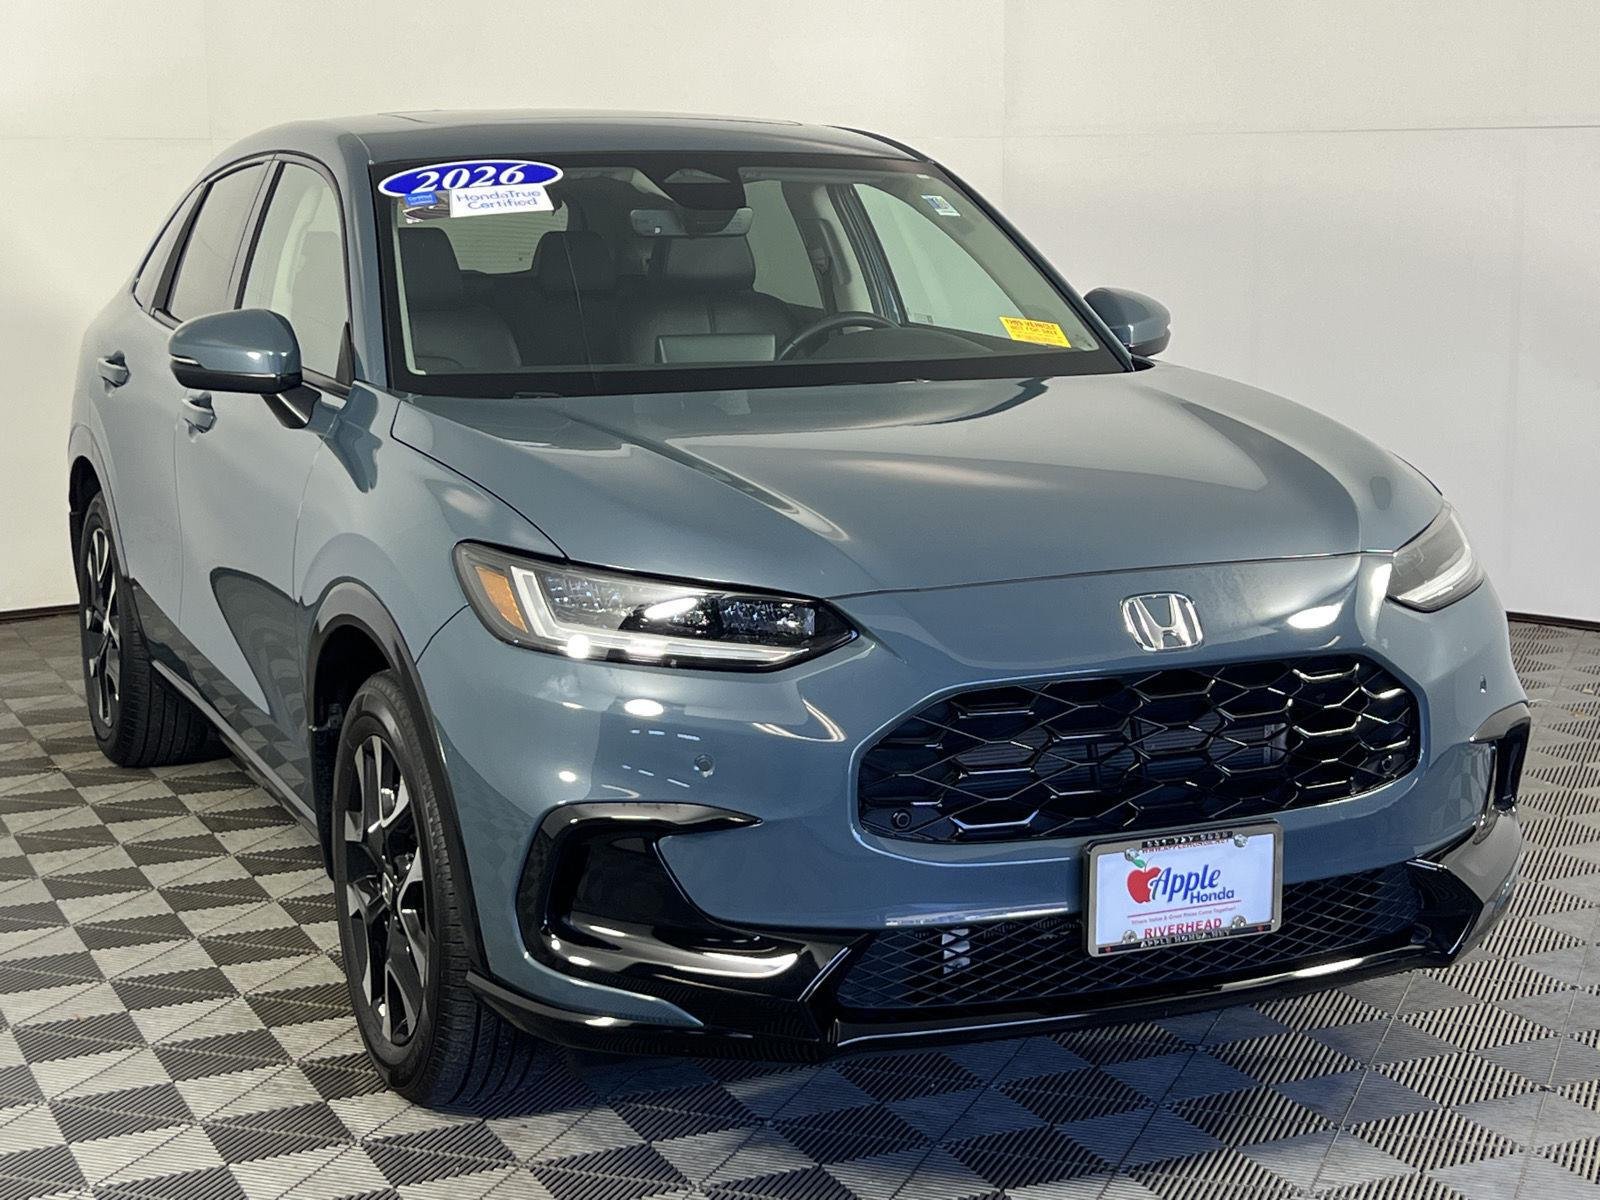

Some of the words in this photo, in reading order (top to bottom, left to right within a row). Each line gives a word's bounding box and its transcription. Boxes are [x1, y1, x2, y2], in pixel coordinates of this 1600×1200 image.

[411, 164, 528, 193] 2026
[456, 190, 541, 203] HondaTrue
[467, 198, 537, 210] Certified
[1149, 864, 1221, 903] Apple
[1189, 886, 1235, 904] Honda
[1144, 918, 1222, 939] RIVERHEAD
